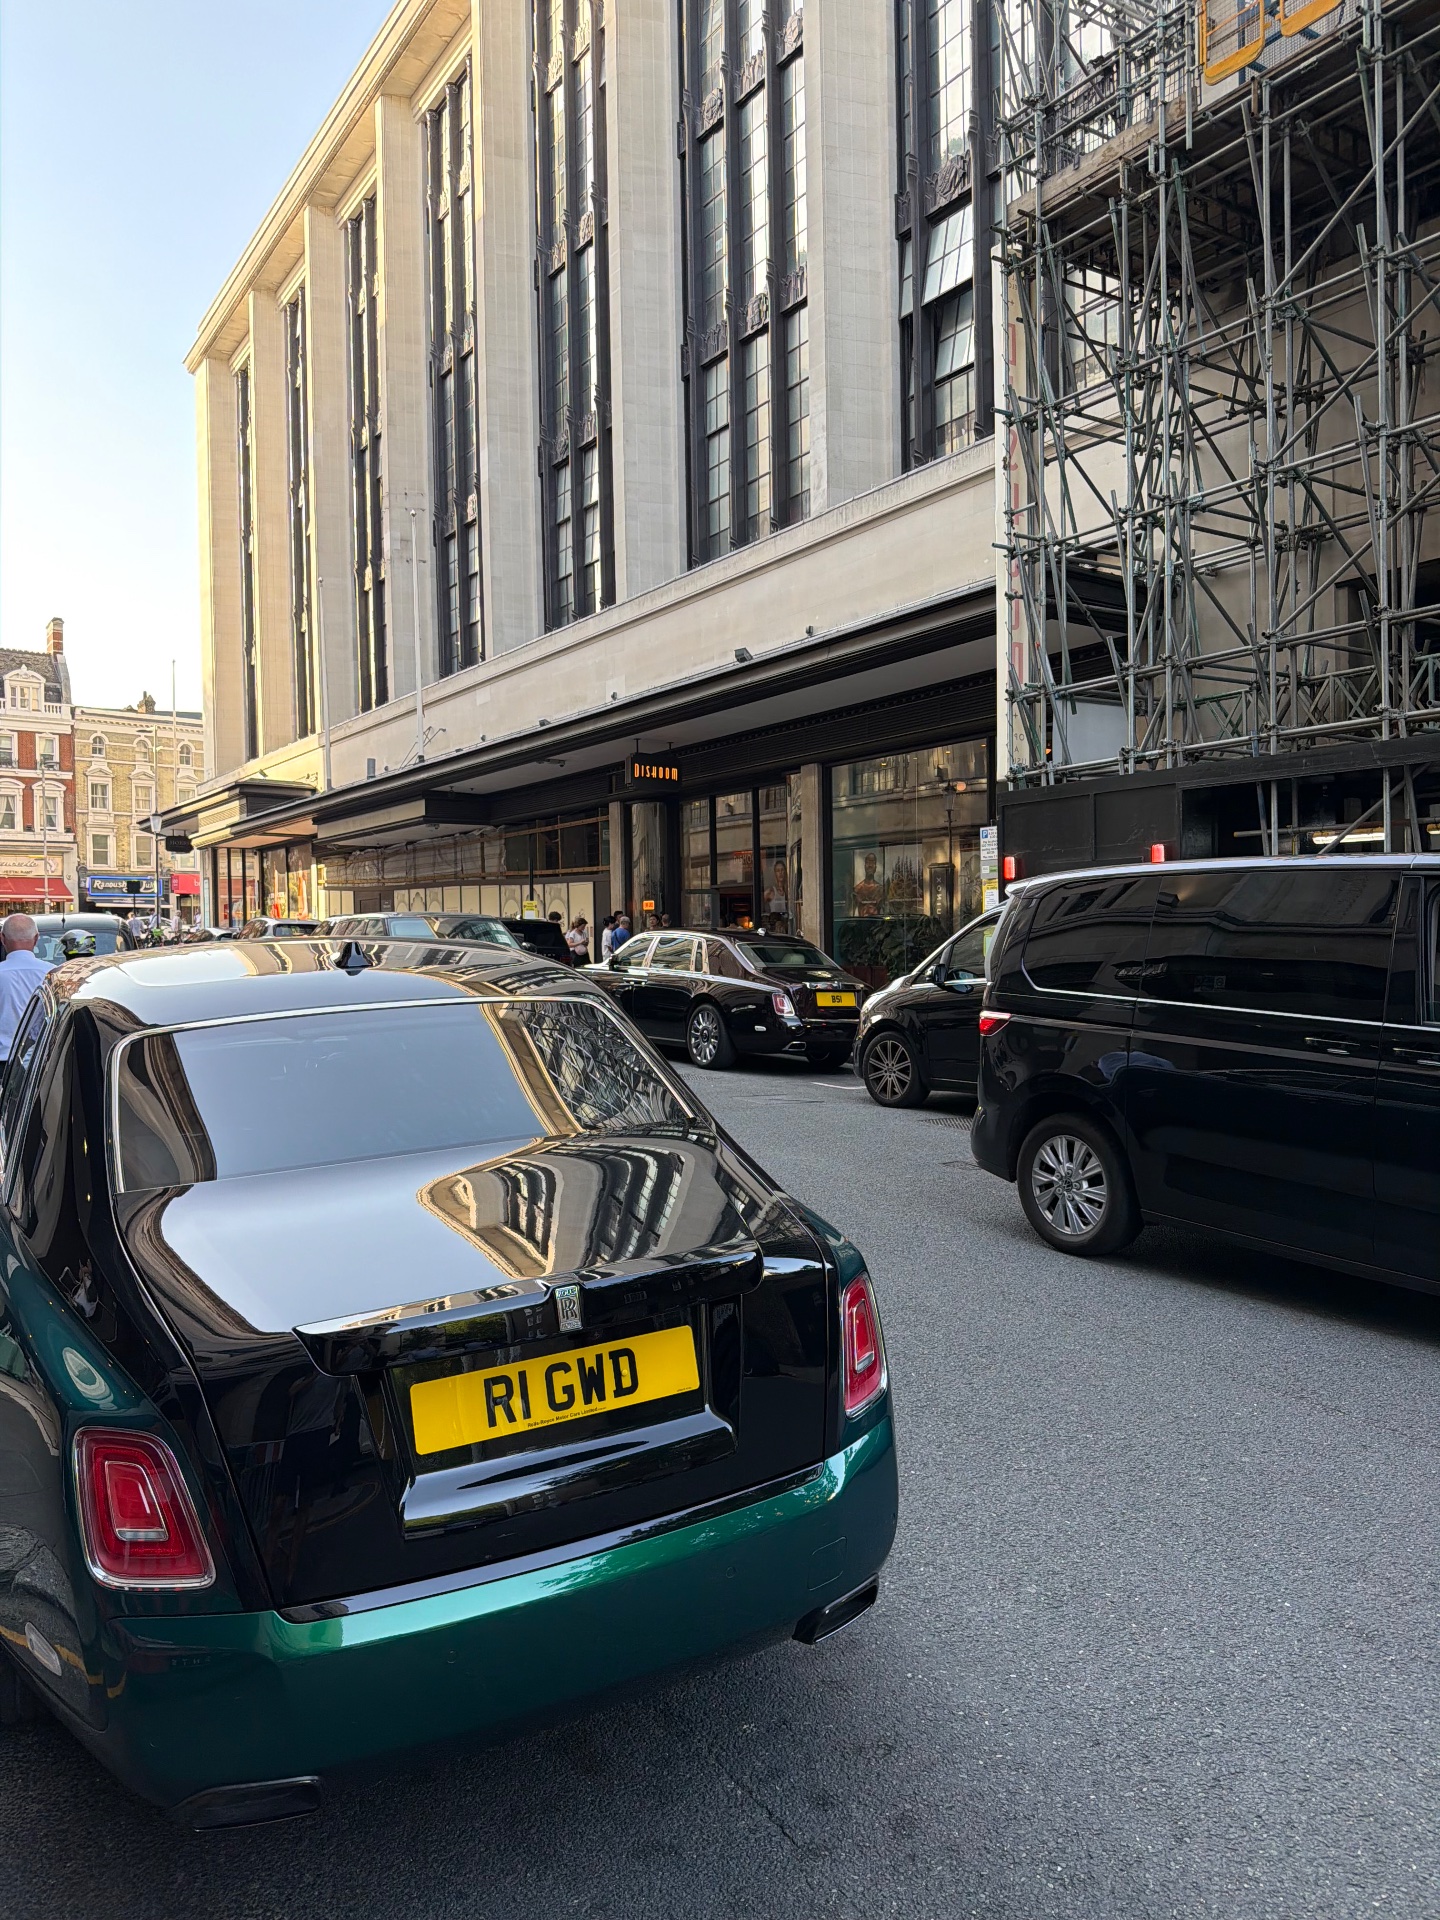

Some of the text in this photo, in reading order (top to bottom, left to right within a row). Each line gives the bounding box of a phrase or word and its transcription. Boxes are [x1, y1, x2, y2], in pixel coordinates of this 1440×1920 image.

[634, 763, 678, 781] DISHOOM
[982, 830, 988, 838] P
[545, 1348, 639, 1412] GWD
[581, 1407, 598, 1415] Limited
